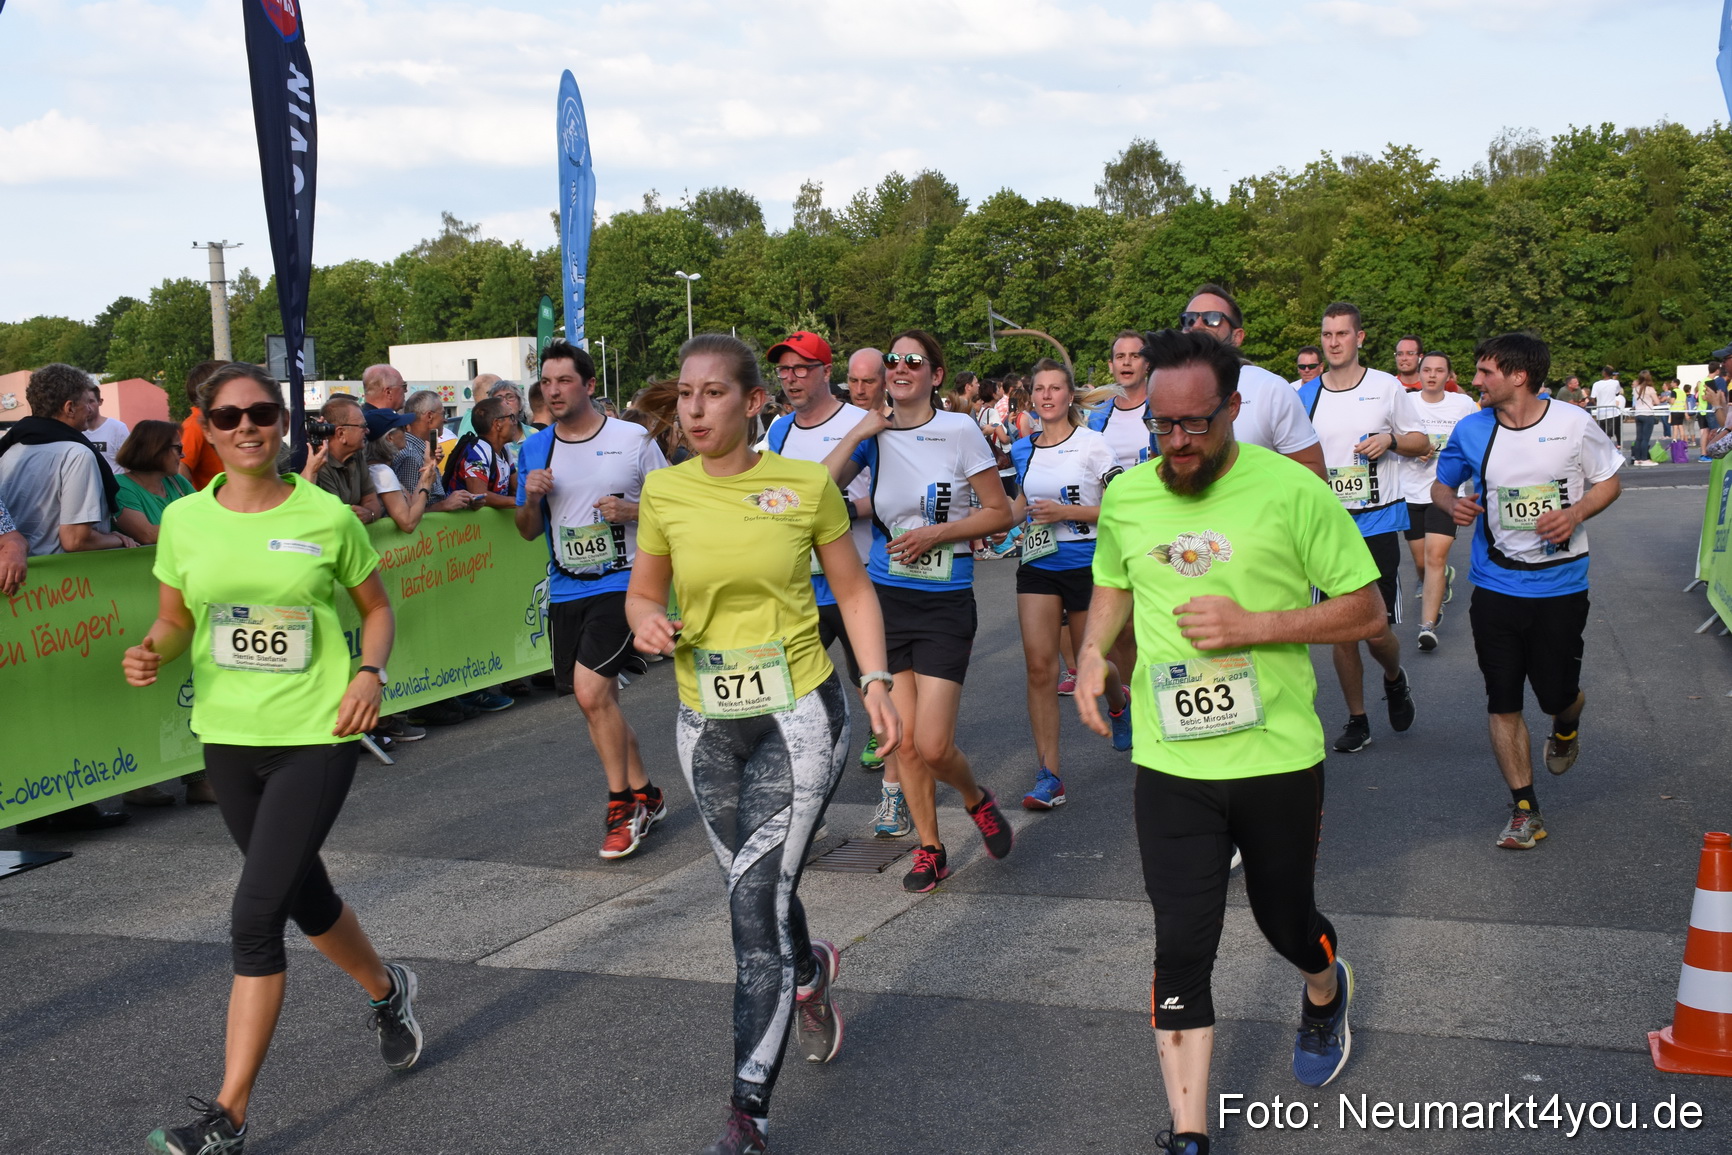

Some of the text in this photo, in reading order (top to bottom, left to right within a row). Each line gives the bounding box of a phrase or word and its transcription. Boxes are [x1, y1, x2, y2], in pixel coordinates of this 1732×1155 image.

[1328, 478, 1363, 492] 1049
[935, 482, 952, 524] HUB
[437, 523, 482, 552] Firmen
[566, 537, 607, 558] 1048
[1024, 530, 1050, 552] 1052
[401, 542, 494, 600] laufen länger!
[31, 600, 125, 658] länger!
[232, 628, 288, 655] 666
[380, 652, 504, 703] rmenlauf-oberpfalz.de
[714, 670, 764, 700] 671
[1228, 672, 1248, 681] 2019
[1175, 684, 1234, 718] 663
[1180, 712, 1238, 726] Bebic Miroslav
